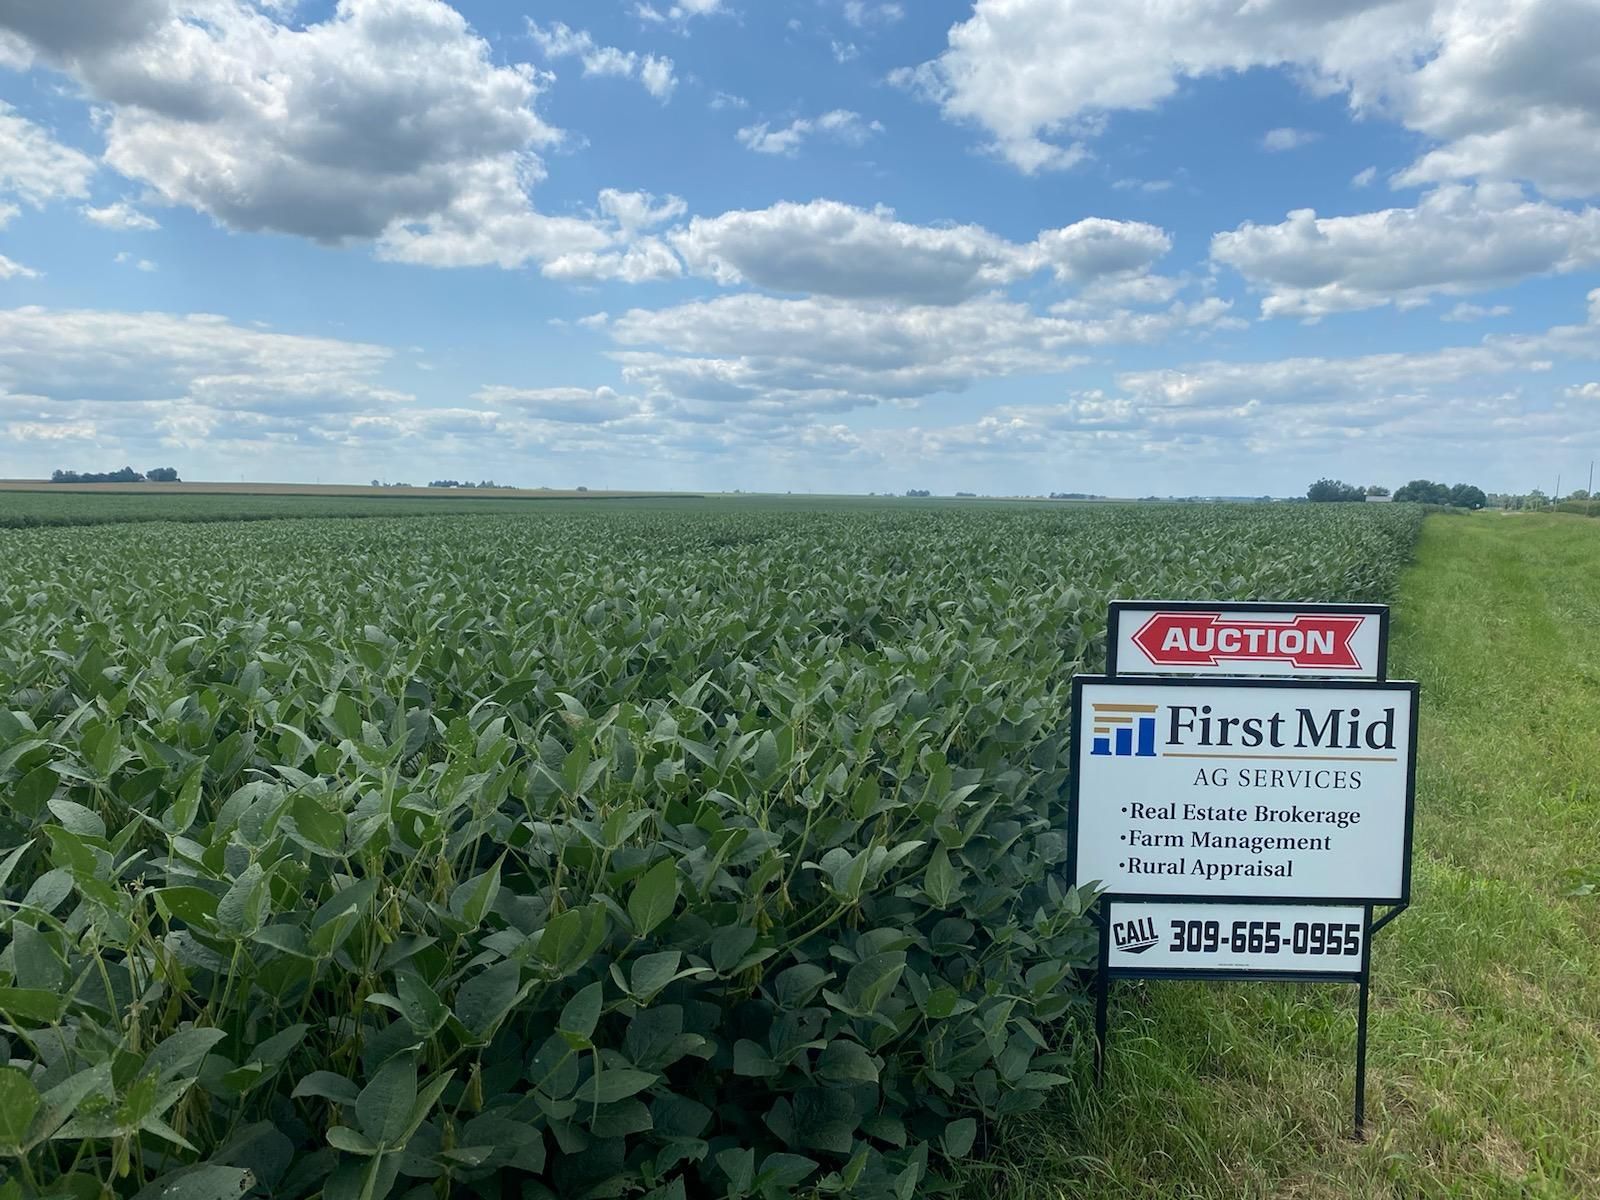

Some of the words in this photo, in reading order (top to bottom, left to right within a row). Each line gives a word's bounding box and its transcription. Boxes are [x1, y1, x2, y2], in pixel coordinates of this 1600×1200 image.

[1161, 627, 1334, 654] AUCTION
[1166, 705, 1285, 748] First
[1294, 708, 1396, 750] Mid
[1193, 768, 1228, 786] AG
[1238, 769, 1362, 789] SERVICES
[1130, 803, 1175, 820] Real
[1183, 804, 1247, 822] Estate
[1254, 806, 1360, 828] Brokerage
[1129, 830, 1184, 847] Farm
[1191, 832, 1331, 854] Management
[1127, 858, 1185, 874] Rural
[1191, 860, 1292, 880] Appraisal
[1113, 917, 1158, 946] CALL
[1170, 920, 1360, 955] 309-665-0955
